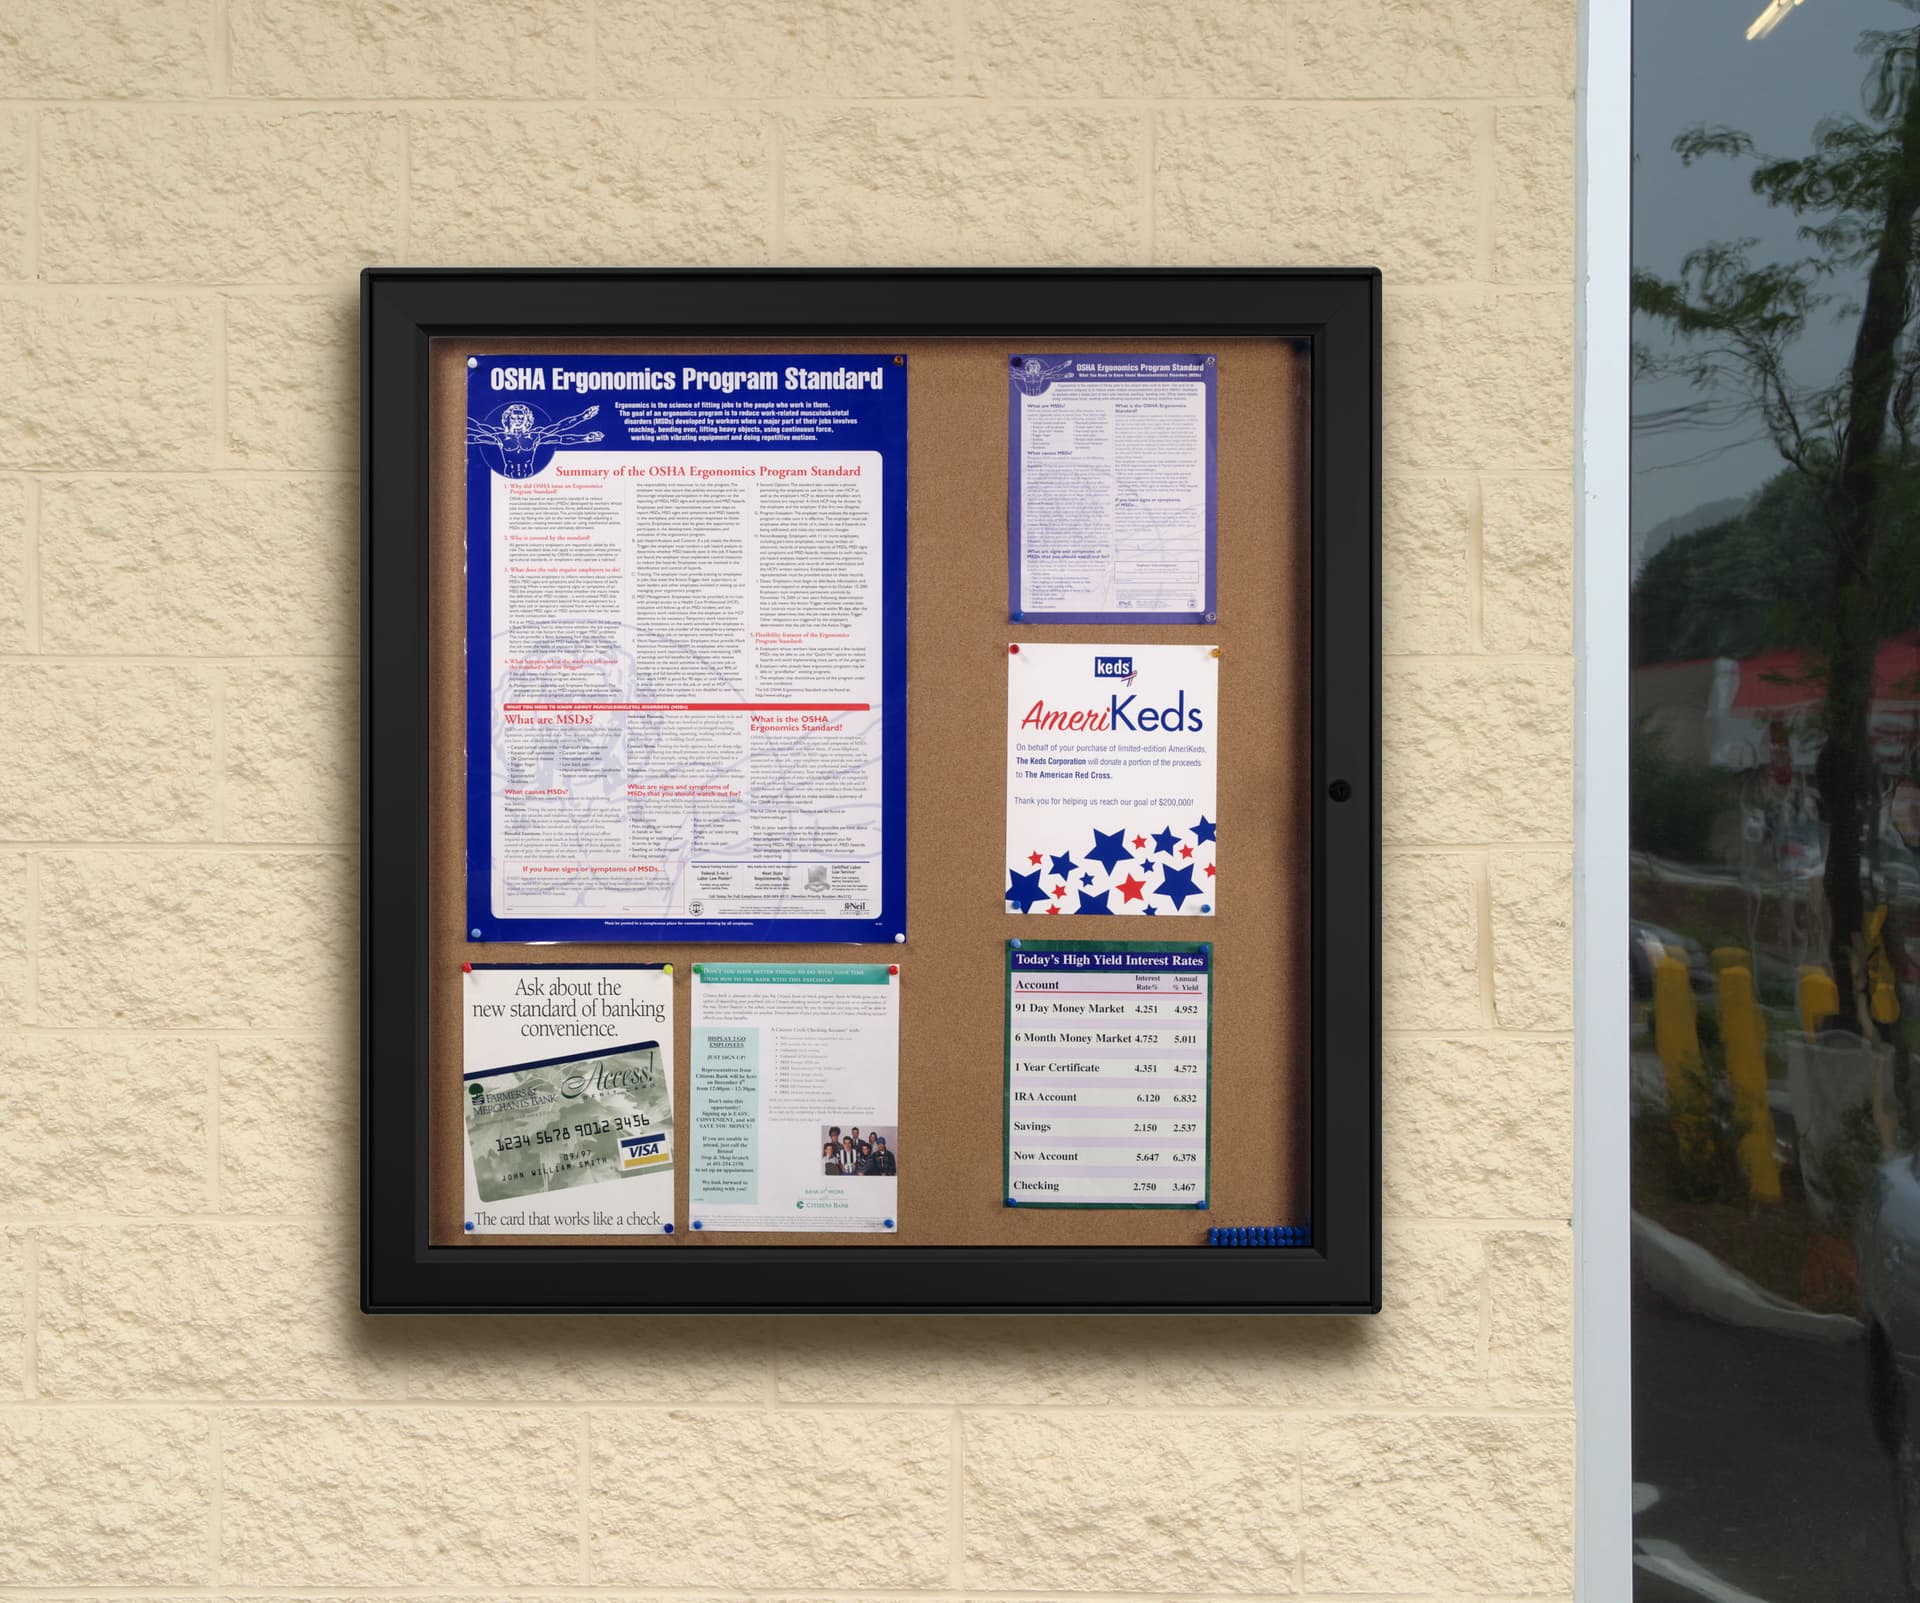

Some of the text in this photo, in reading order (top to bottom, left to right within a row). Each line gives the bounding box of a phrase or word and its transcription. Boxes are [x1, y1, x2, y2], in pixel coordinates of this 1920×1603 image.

[1077, 363, 1204, 373] OSHA Ergonomics Program Standard
[491, 367, 883, 394] OSHA Ergonomics Program Standard
[631, 433, 655, 442] working
[670, 433, 697, 442] vibrating
[698, 434, 730, 442] equipment
[743, 434, 760, 442] doing
[761, 433, 790, 442] repetitive
[556, 465, 861, 480] Summary of the OSHA Ergonomics Program Standard
[1097, 659, 1129, 674] keds
[1021, 690, 1203, 732] AmeriKeds
[504, 714, 534, 724] What
[557, 714, 593, 724] MSDs?
[750, 715, 774, 725] What
[801, 715, 829, 725] OSHA
[750, 723, 843, 733] Ergonomics Standard?
[1016, 743, 1026, 751] On
[1059, 745, 1075, 753] your
[1076, 744, 1108, 753] purchase
[1109, 744, 1116, 752] of
[1117, 744, 1167, 752] limited-edition
[1016, 757, 1029, 765] The
[1030, 757, 1046, 765] Keds
[1048, 757, 1086, 766] Corporation
[1040, 771, 1073, 779] American
[1075, 771, 1089, 779] Red
[1091, 771, 1112, 779] Cross.
[1014, 796, 1035, 805] Thank
[1036, 798, 1049, 806] you
[1051, 797, 1061, 805] for
[1062, 798, 1088, 807] helping
[1099, 798, 1119, 806] reach
[1133, 798, 1148, 807] goal
[1150, 798, 1157, 806] of
[1016, 954, 1203, 967] Today's High Yield Interest Rates
[515, 977, 621, 996] Ask about the
[1016, 980, 1059, 989] Account
[473, 999, 665, 1023] new standard of banking
[1015, 1003, 1198, 1015] 91 Day Money Market 4.251 4.952
[521, 1021, 618, 1037] convenience.
[1015, 1033, 1196, 1045] 6 Month Money Market 4.752 5.011
[1016, 1063, 1019, 1071] 1
[1024, 1063, 1046, 1071] Year
[1049, 1063, 1100, 1072] Certificate
[1174, 1065, 1197, 1073] 4.572
[560, 1051, 655, 1099] Access!
[486, 1090, 527, 1104] FARMERS
[1015, 1092, 1197, 1103] IRA Account 6.120 6.832
[473, 1093, 557, 1117] MERCHANTS BANK
[495, 1113, 650, 1152] 1234 5678 9012 3456
[1014, 1122, 1196, 1132] Savings 2.150 2.537
[563, 1149, 592, 1161] 09/97
[629, 1143, 660, 1158] VISA
[1014, 1151, 1196, 1162] Now Account 5.647 6.378
[501, 1157, 607, 1182] JOHN WILLIAM SMITH
[1013, 1181, 1196, 1191] Checking 2.750 3.467
[474, 1211, 665, 1228] The card that works like a check.
